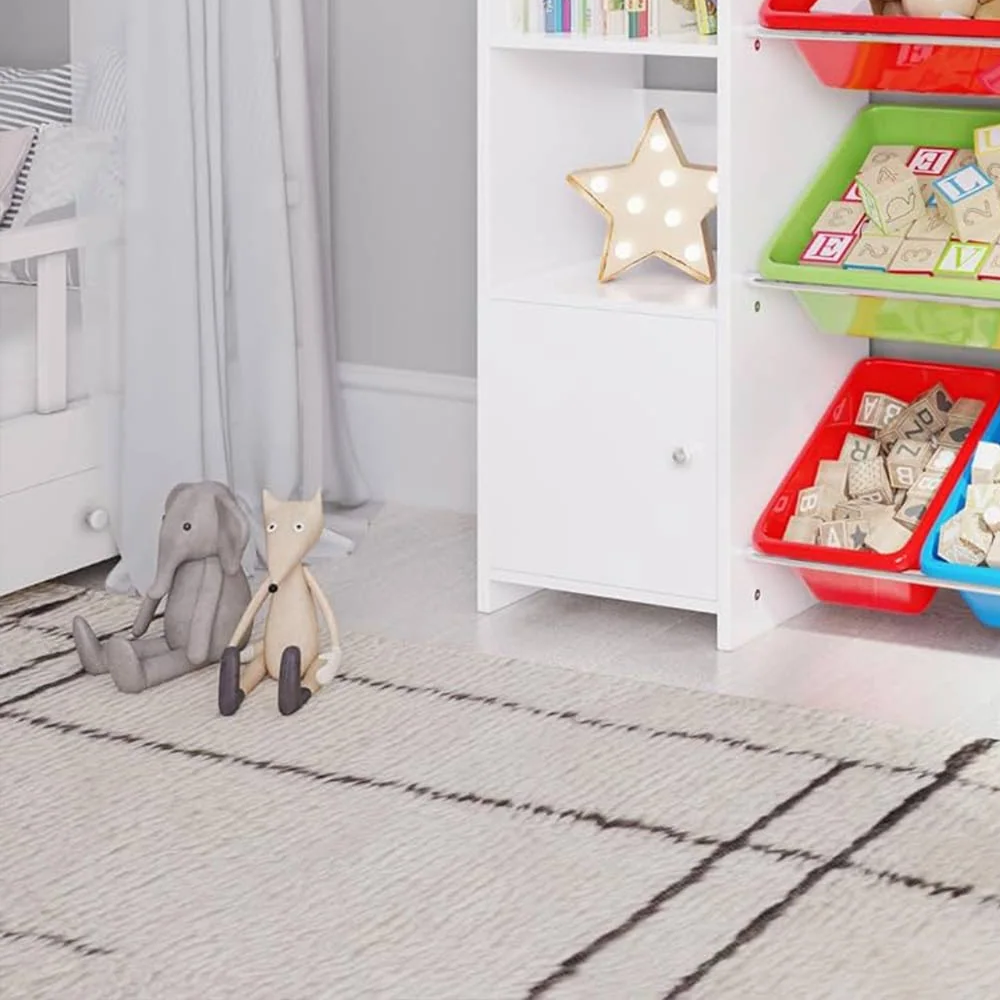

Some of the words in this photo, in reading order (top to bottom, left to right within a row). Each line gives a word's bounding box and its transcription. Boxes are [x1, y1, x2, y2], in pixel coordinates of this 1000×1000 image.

[943, 176, 982, 197] L
[809, 236, 845, 259] E
[952, 246, 982, 269] V
